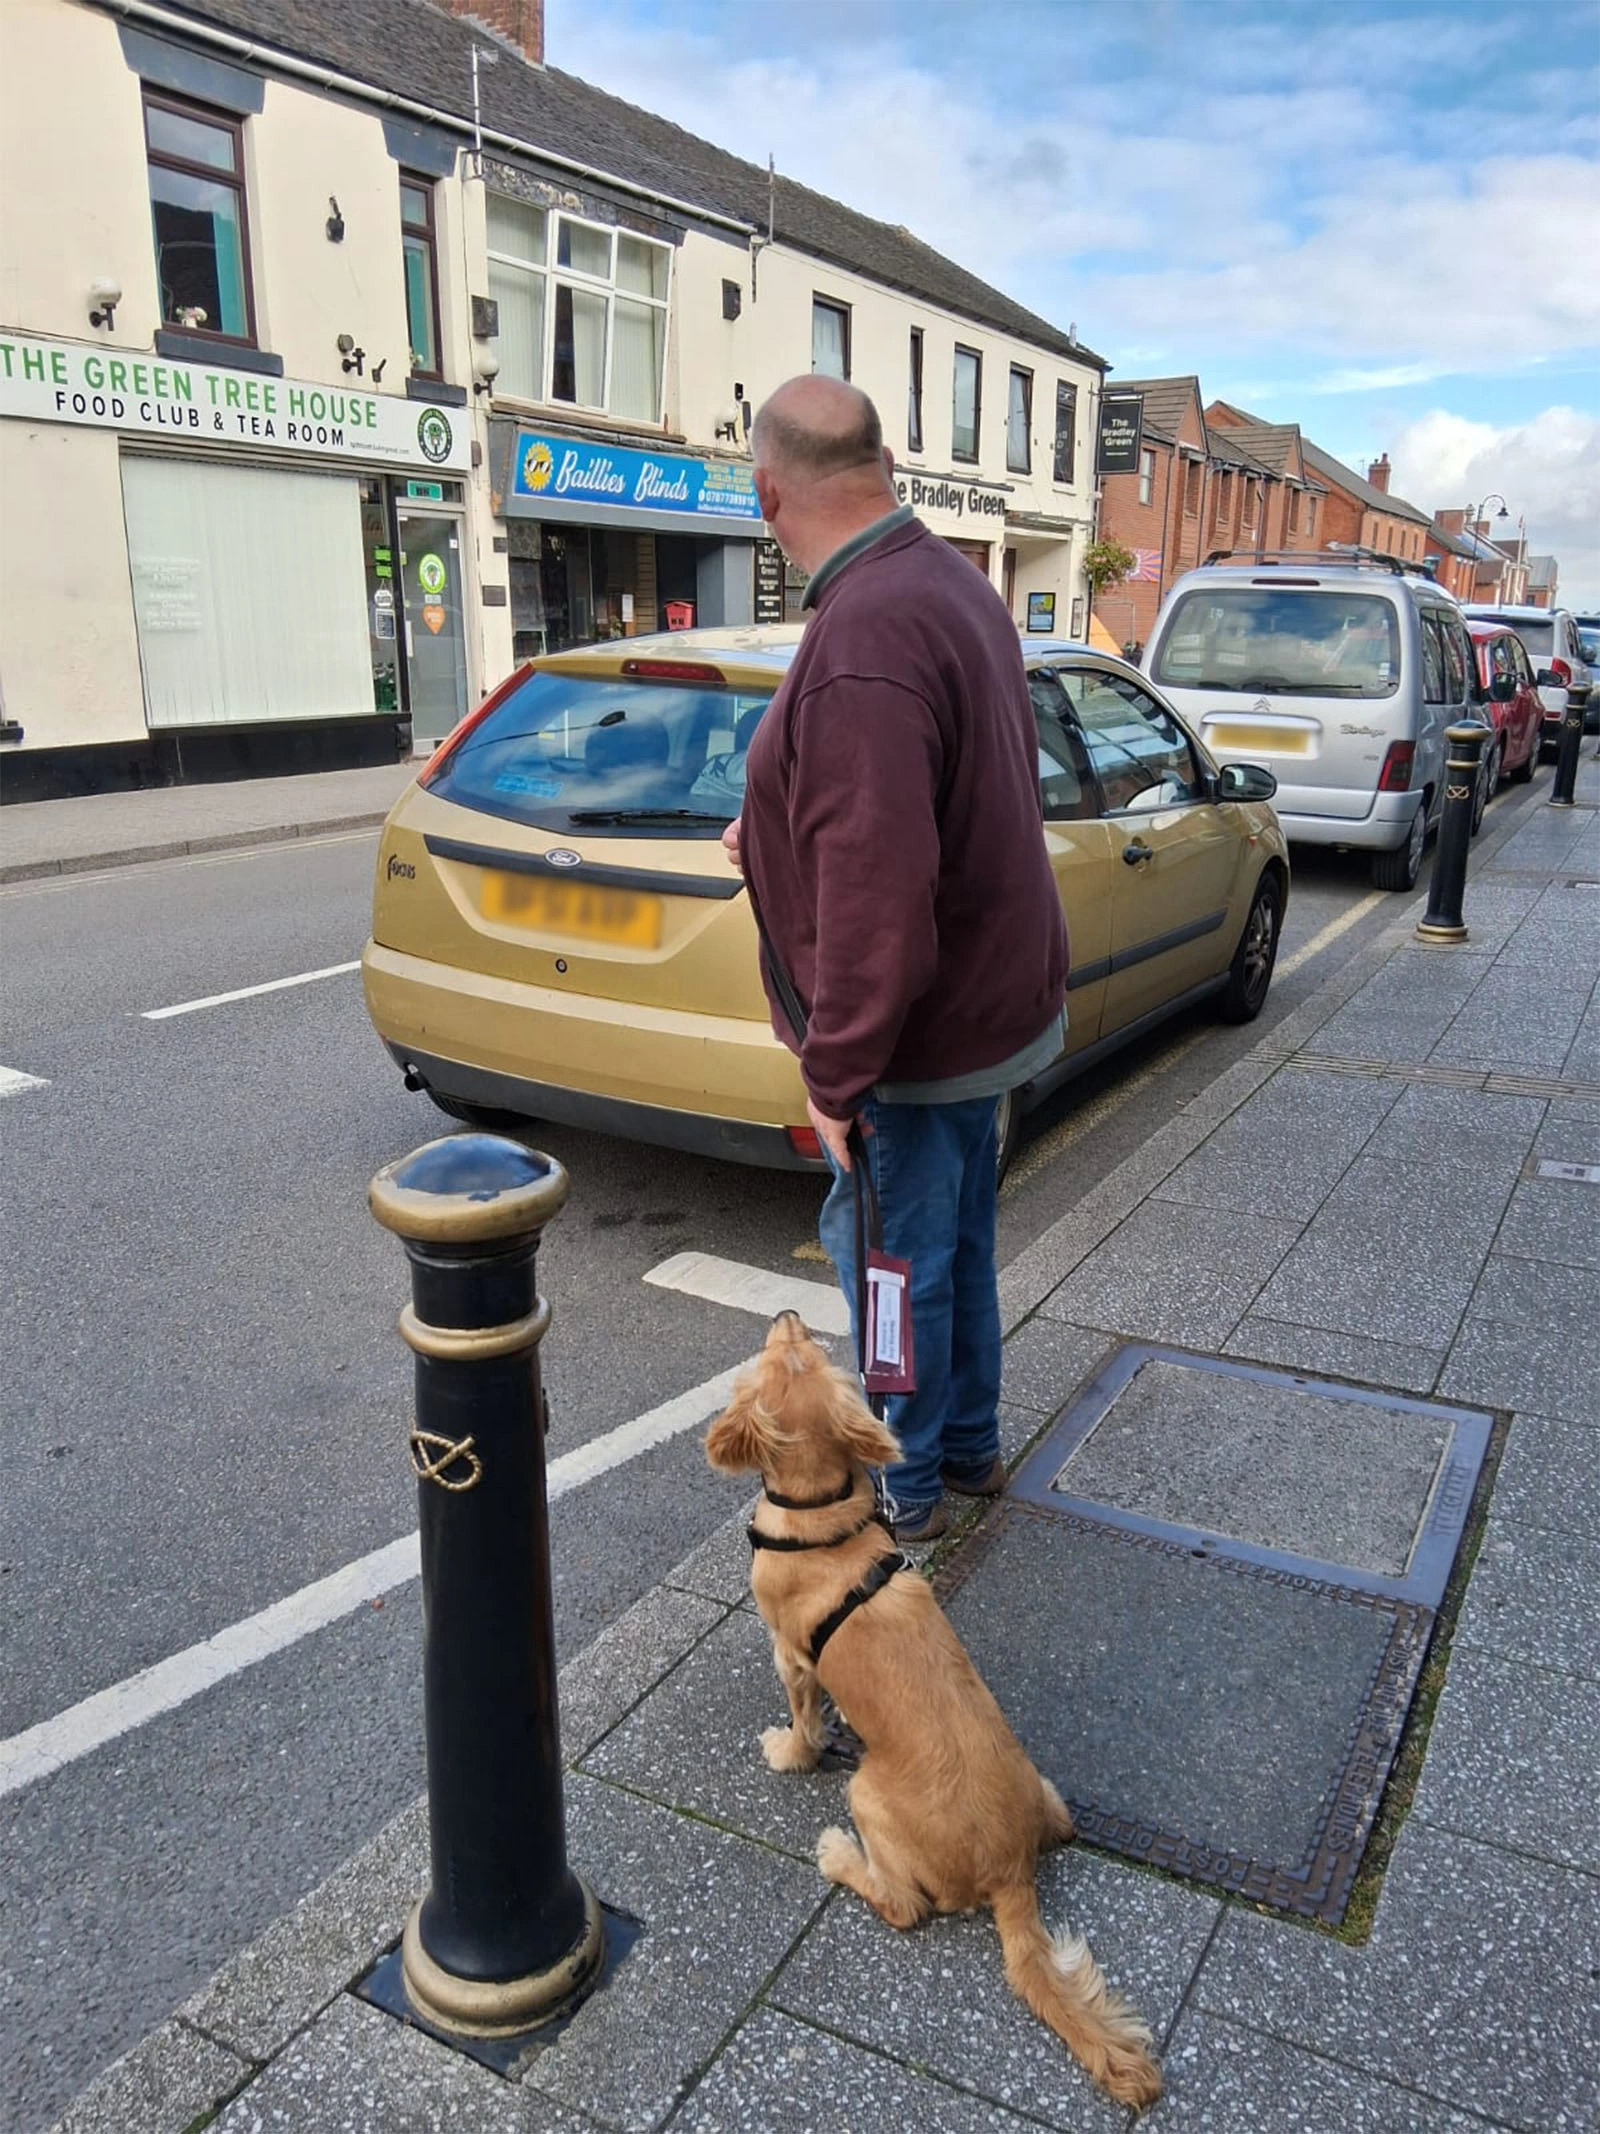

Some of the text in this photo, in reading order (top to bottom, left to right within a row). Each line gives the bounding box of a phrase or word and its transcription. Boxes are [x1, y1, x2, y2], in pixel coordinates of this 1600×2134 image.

[0, 344, 377, 428] THE GREEN TREE HOUSE
[56, 391, 344, 446] FOOD CLUB & TEA ROOM
[1102, 428, 1136, 438] Bradley
[1112, 418, 1129, 428] The
[1105, 437, 1132, 447] Green
[555, 450, 626, 493] Baillies
[633, 461, 689, 502] Blinds
[911, 478, 964, 517] Bradley
[968, 487, 1006, 516] Green
[1208, 1555, 1354, 1601] TELEPHONES
[1386, 1638, 1414, 1677] POST
[1327, 1747, 1381, 1853] TELEPHONES
[1175, 1849, 1248, 1882] POST
